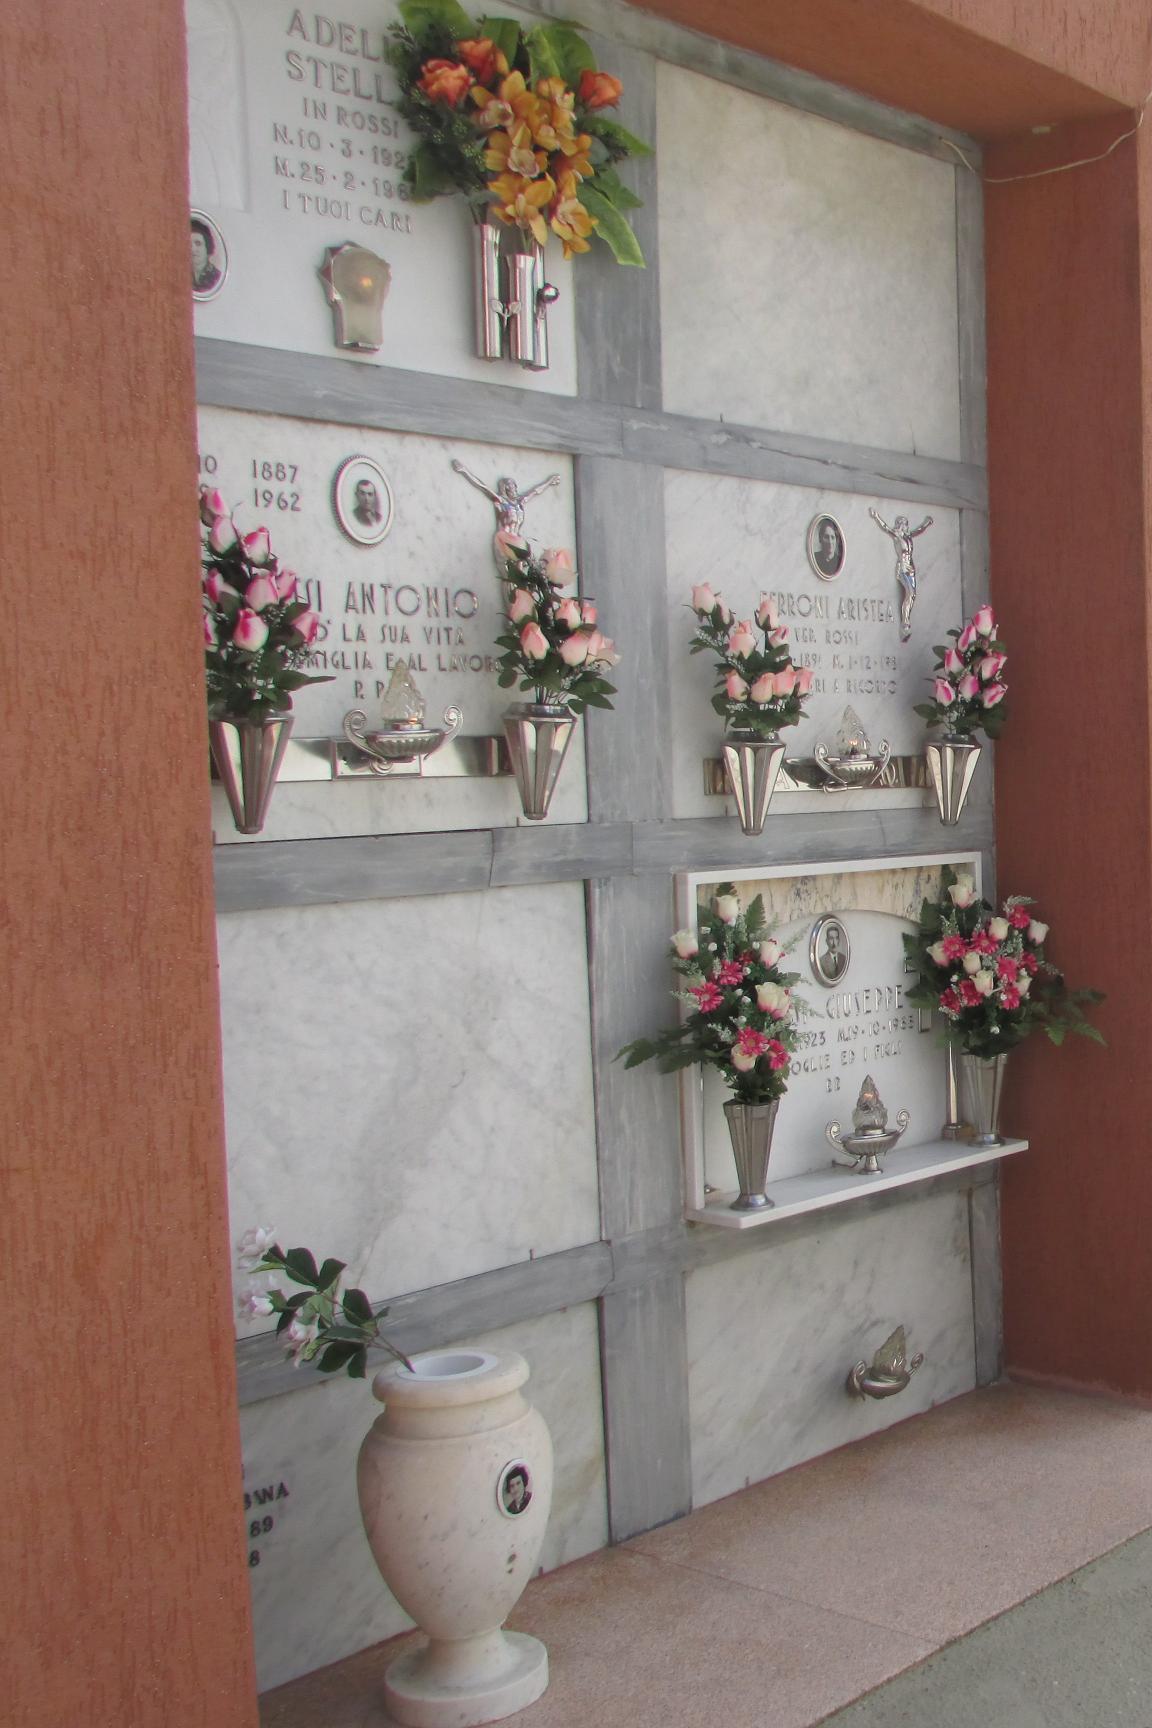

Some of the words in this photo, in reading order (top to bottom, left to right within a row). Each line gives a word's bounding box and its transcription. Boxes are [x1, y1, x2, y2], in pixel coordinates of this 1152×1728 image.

[287, 51, 393, 106] STELL
[303, 97, 327, 120] IN
[337, 105, 400, 138] ROSSI
[282, 189, 289, 210] I
[297, 193, 351, 221] TUOI
[360, 205, 413, 234] CARI
[252, 458, 298, 484] 1887
[254, 488, 302, 512] 1962
[344, 581, 479, 619] ANTONIO
[838, 597, 895, 623] ARISTEA
[343, 624, 366, 642] LA
[381, 624, 410, 643] SUA
[423, 627, 464, 645] VITA
[825, 629, 858, 645] ROSSI
[408, 653, 427, 672] AL
[826, 985, 903, 1019] GIUSEPPE
[790, 1054, 830, 1075] OGLIE
